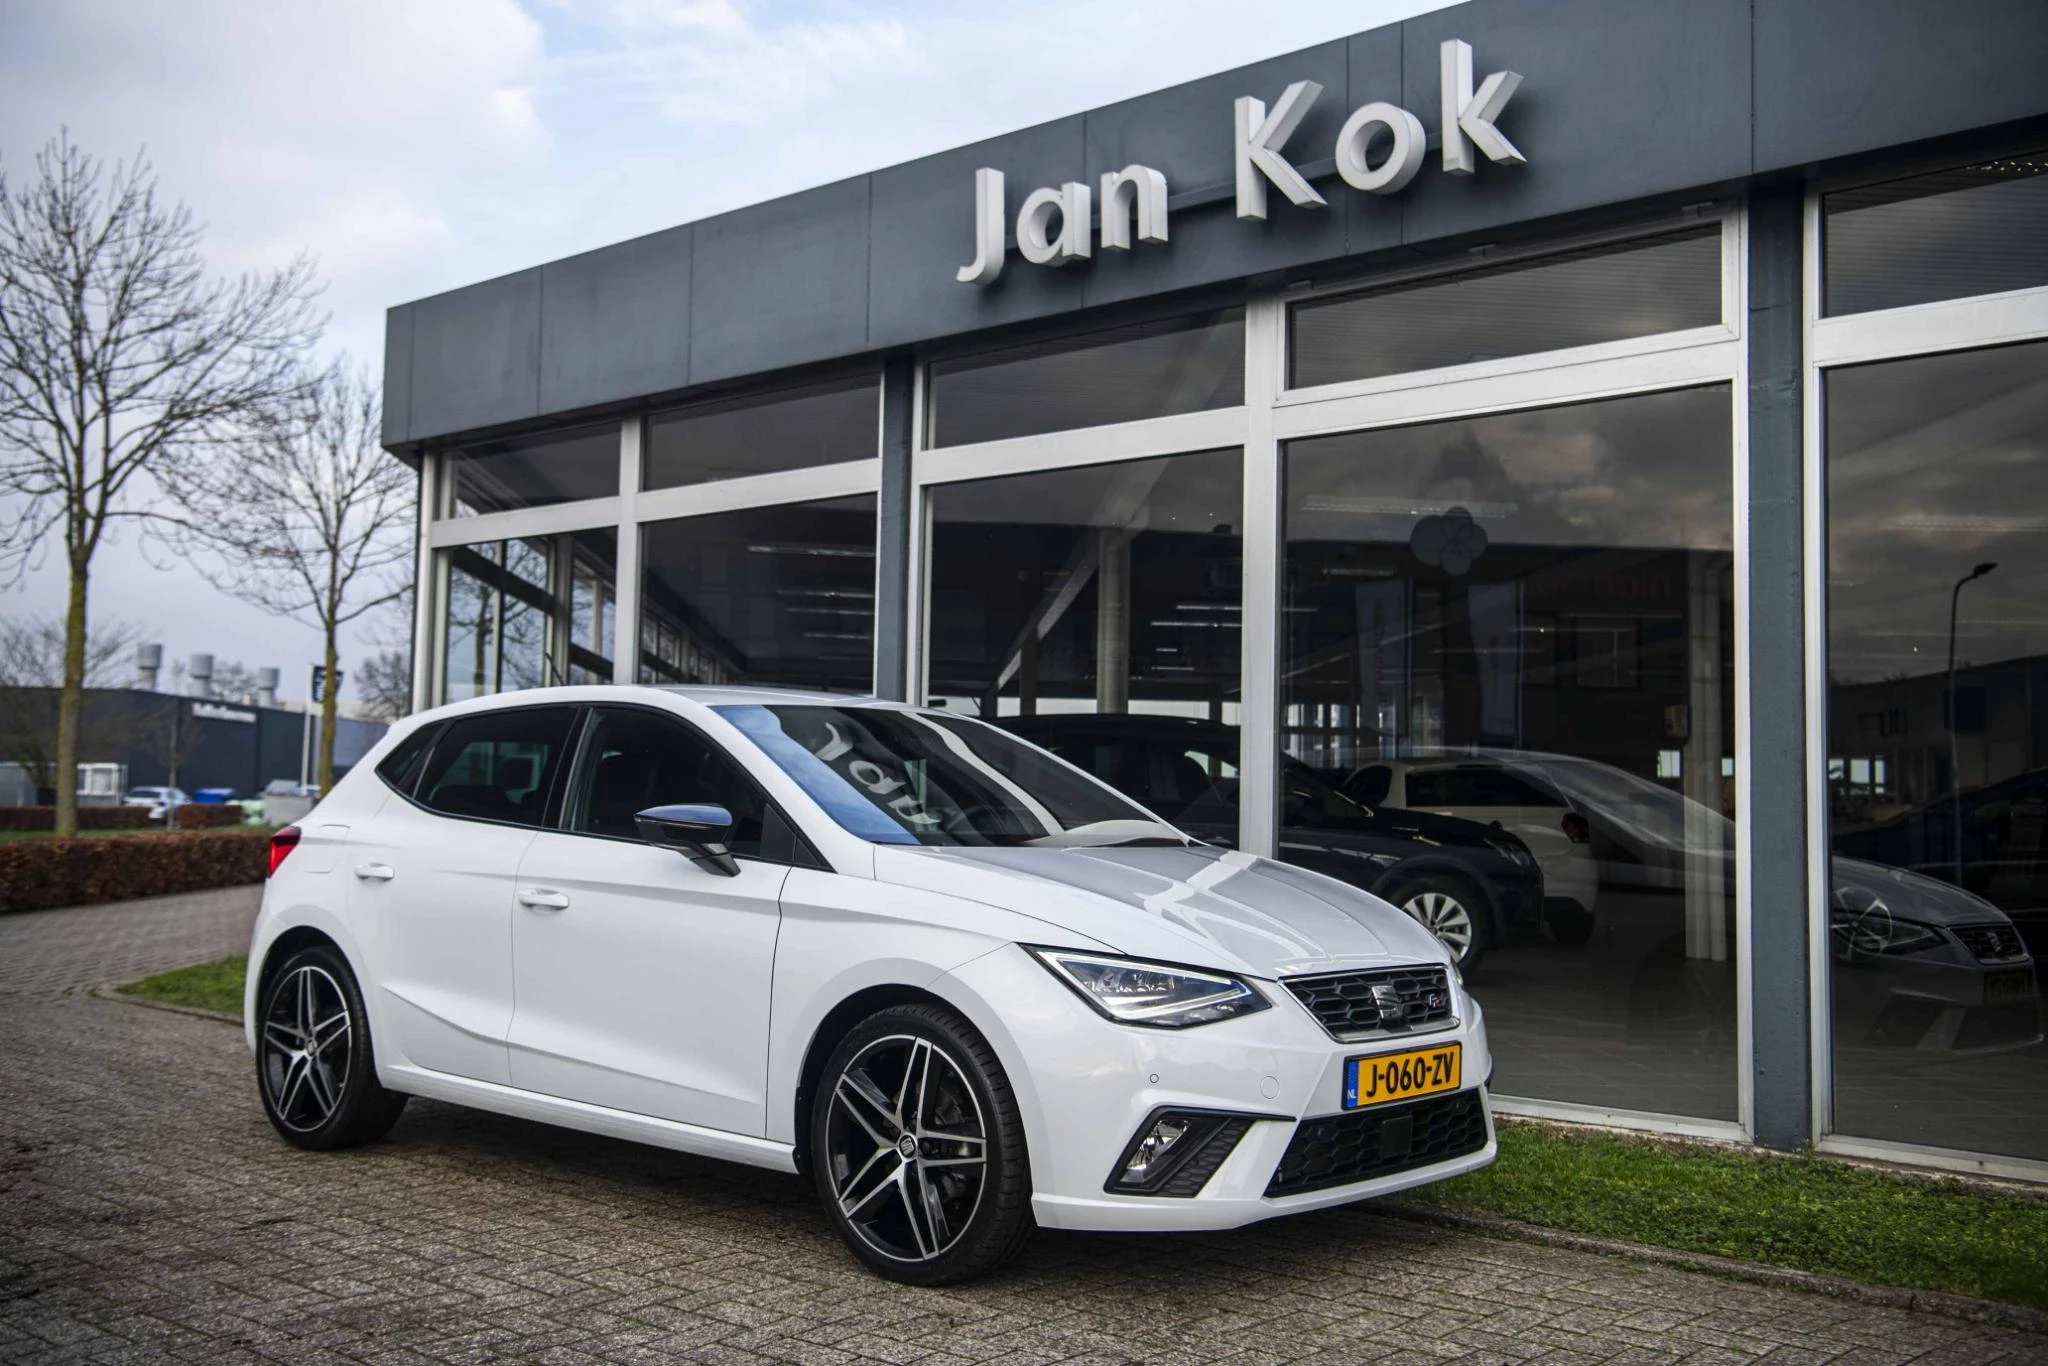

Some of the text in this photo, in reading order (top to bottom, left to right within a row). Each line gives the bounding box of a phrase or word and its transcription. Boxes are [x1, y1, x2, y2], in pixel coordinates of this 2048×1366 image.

[956, 38, 1528, 285] Jan Kok
[1347, 1052, 1455, 1099] NL J-060-ZV
